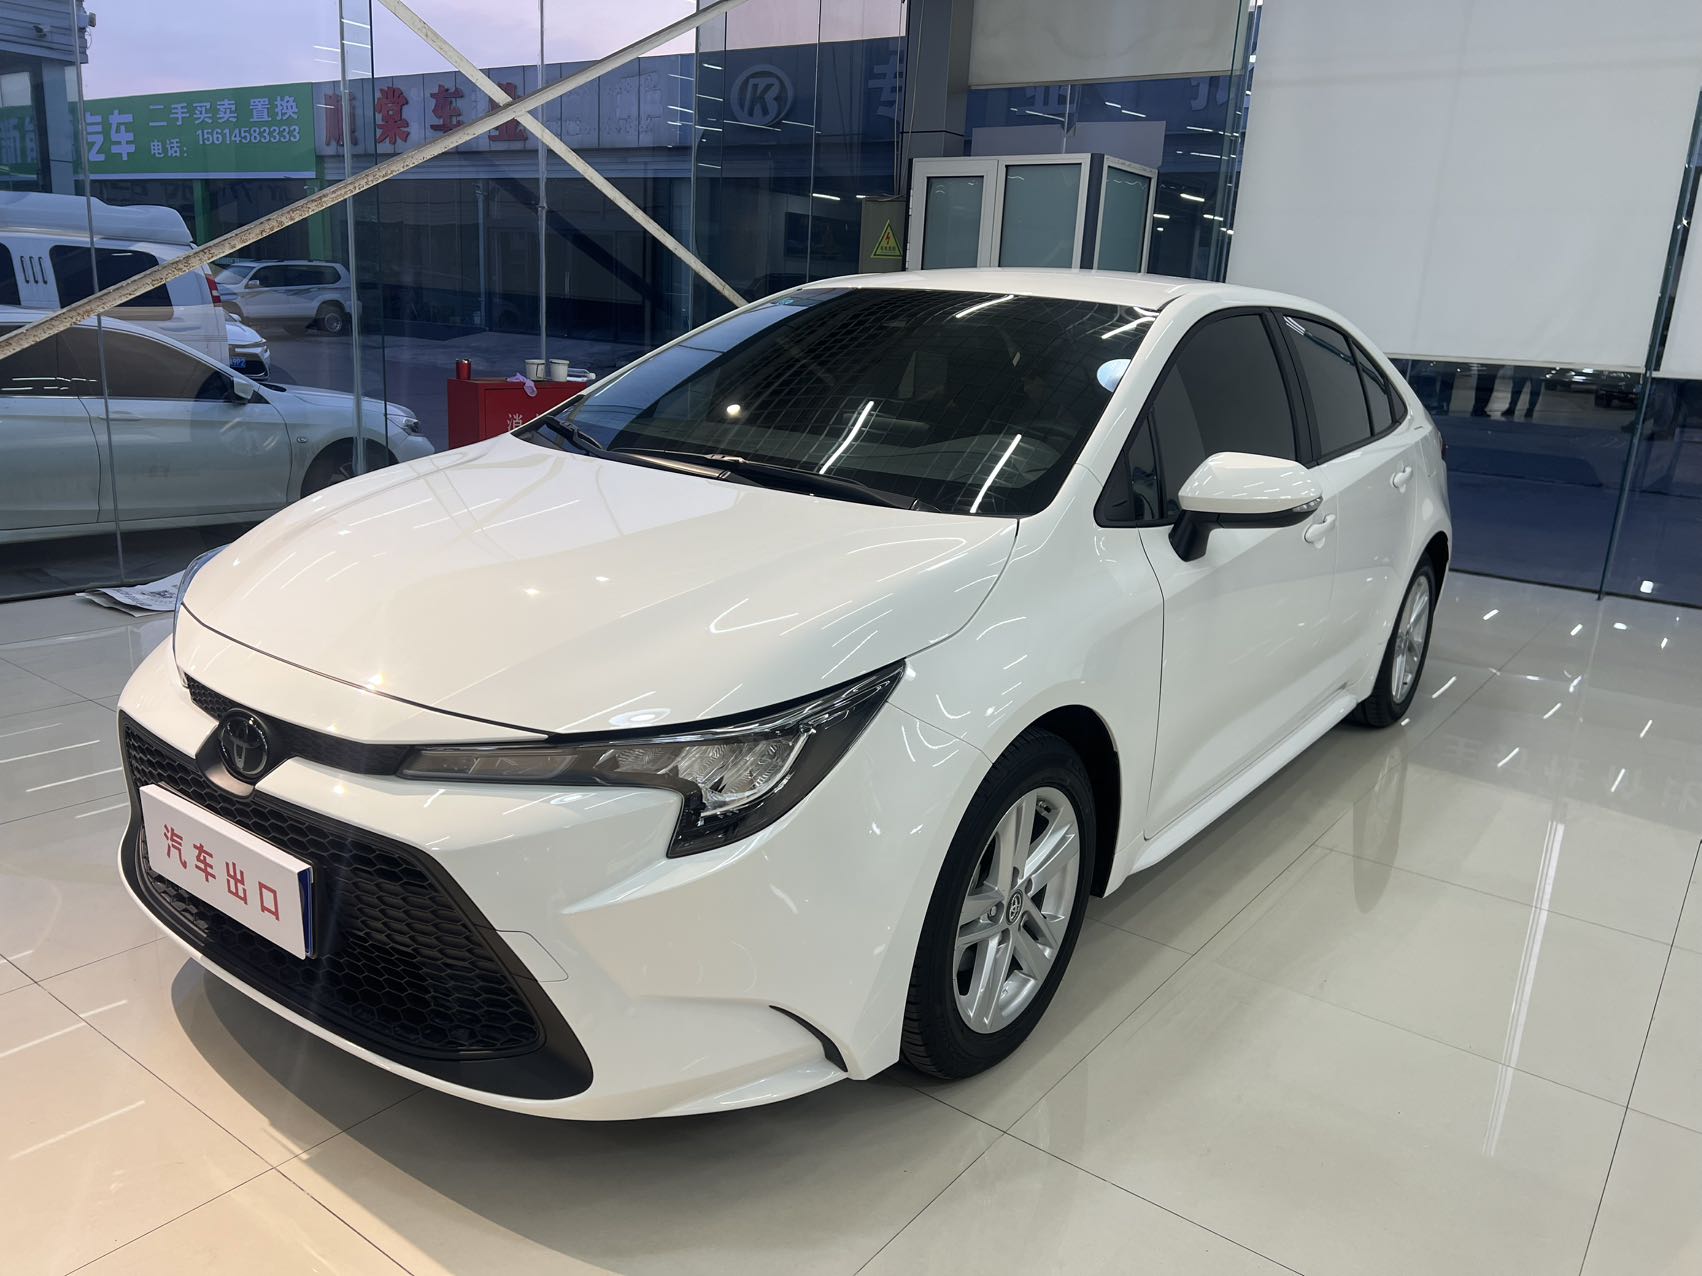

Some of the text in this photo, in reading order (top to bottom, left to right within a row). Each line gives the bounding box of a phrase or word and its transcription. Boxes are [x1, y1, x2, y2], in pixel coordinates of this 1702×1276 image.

[149, 96, 299, 126] 二手买卖 置换
[196, 125, 300, 145] 15614583333
[163, 824, 280, 922] 汽车出口
